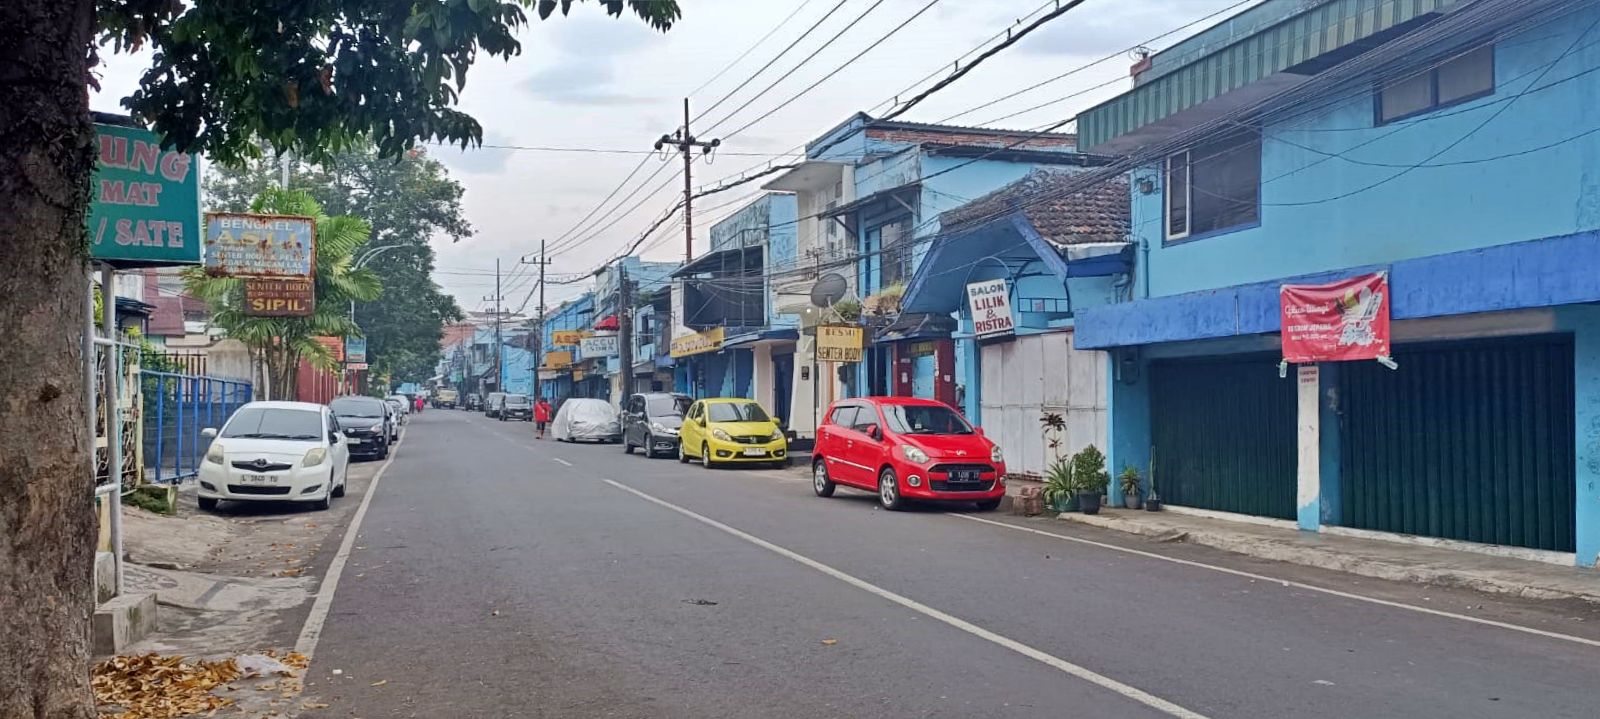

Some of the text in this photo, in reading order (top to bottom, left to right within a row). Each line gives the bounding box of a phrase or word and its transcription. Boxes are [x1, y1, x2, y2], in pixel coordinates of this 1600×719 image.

[221, 218, 293, 231] BENGKEL
[115, 219, 184, 248] SATE
[246, 282, 310, 291] SENTER BODY
[970, 283, 1005, 297] SALON
[974, 295, 1005, 310] LILIK
[975, 316, 1013, 333] RISTRA
[585, 338, 615, 348] ACCU
[818, 346, 861, 360] SENTER BODY
